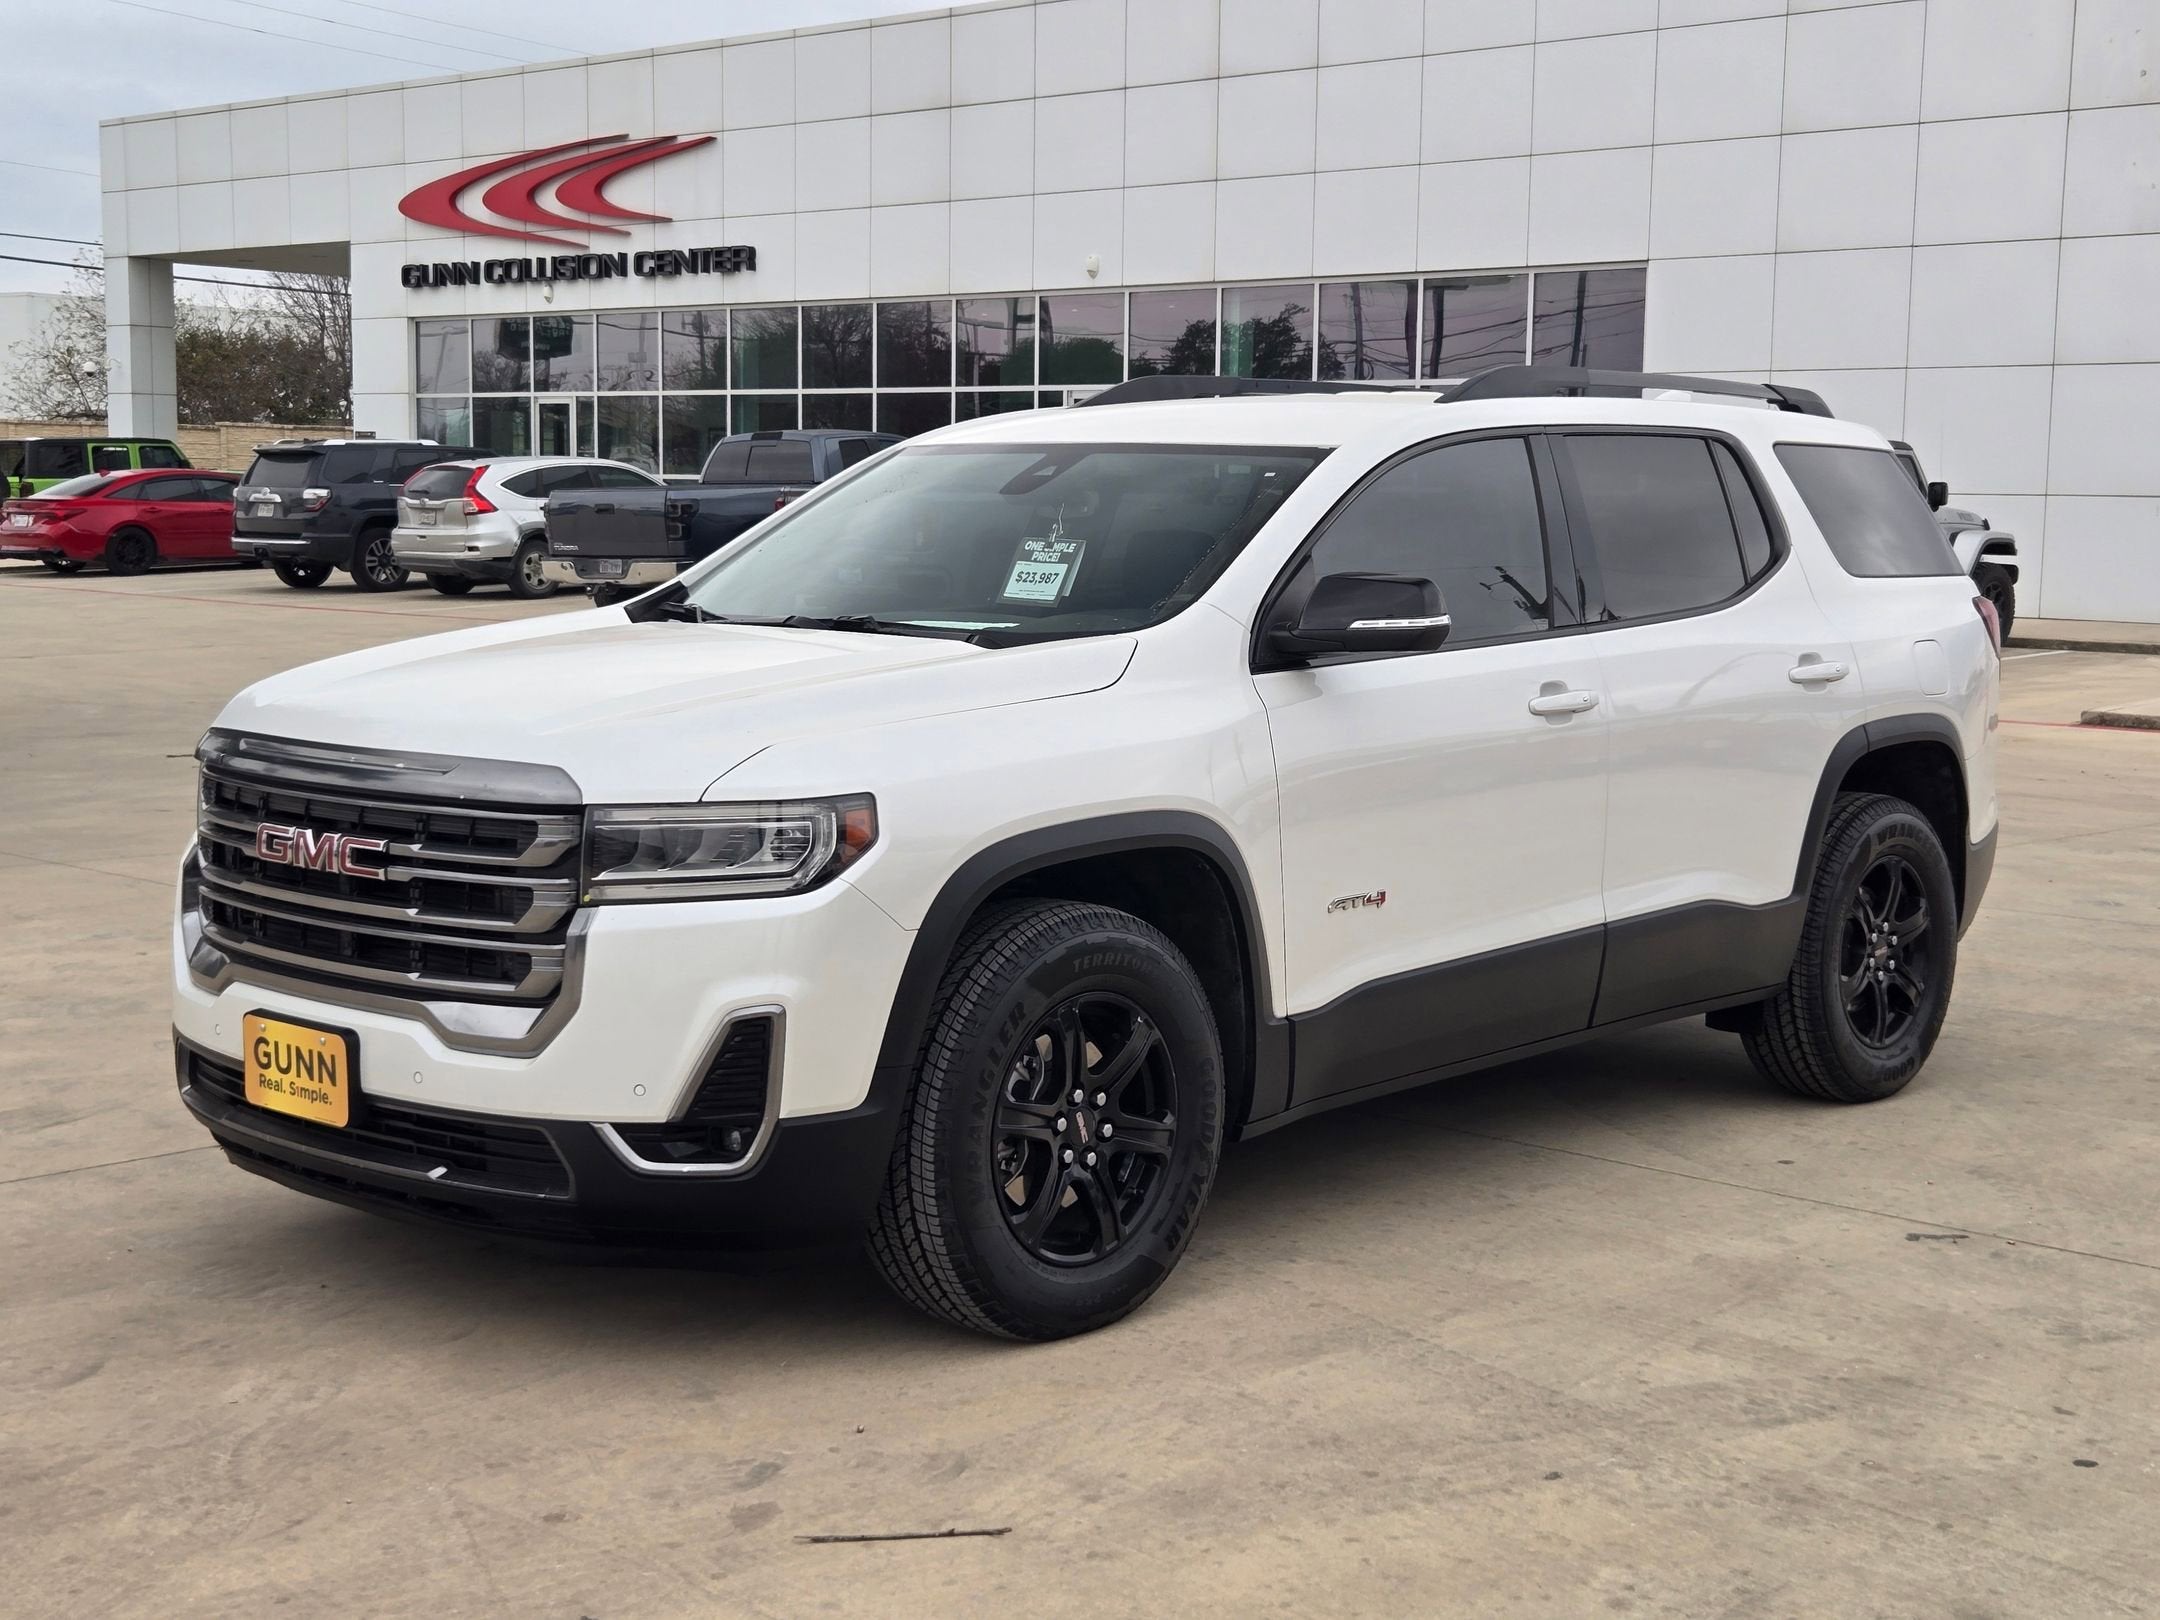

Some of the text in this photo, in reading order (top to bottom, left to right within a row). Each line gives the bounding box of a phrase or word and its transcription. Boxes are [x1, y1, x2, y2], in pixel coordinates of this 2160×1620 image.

[401, 245, 756, 288] GUNN COLLISION CENTER
[1024, 541, 1076, 553] ONE MPLE
[1031, 552, 1061, 562] PRICE!
[1015, 571, 1059, 585] $23,987
[256, 822, 389, 881] GMC
[254, 1036, 337, 1087] GUNN
[259, 1073, 287, 1094] Real.
